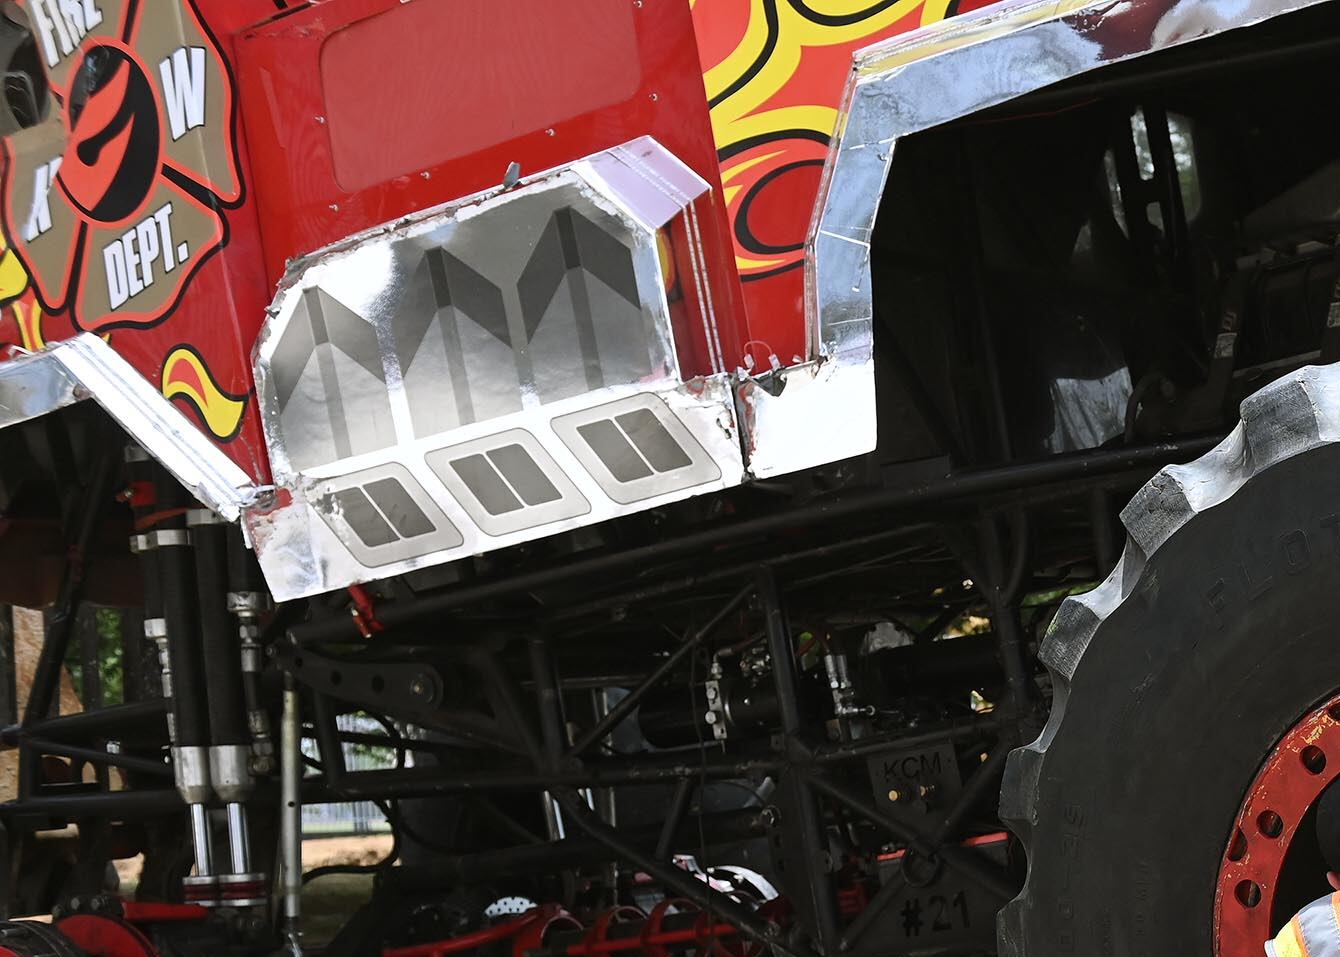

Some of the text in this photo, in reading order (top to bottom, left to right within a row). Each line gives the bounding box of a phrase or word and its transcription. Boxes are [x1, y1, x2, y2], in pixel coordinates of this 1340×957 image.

[159, 46, 207, 141] W
[103, 201, 189, 311] DEPT.
[883, 752, 942, 782] KCM
[901, 889, 970, 937] #21
